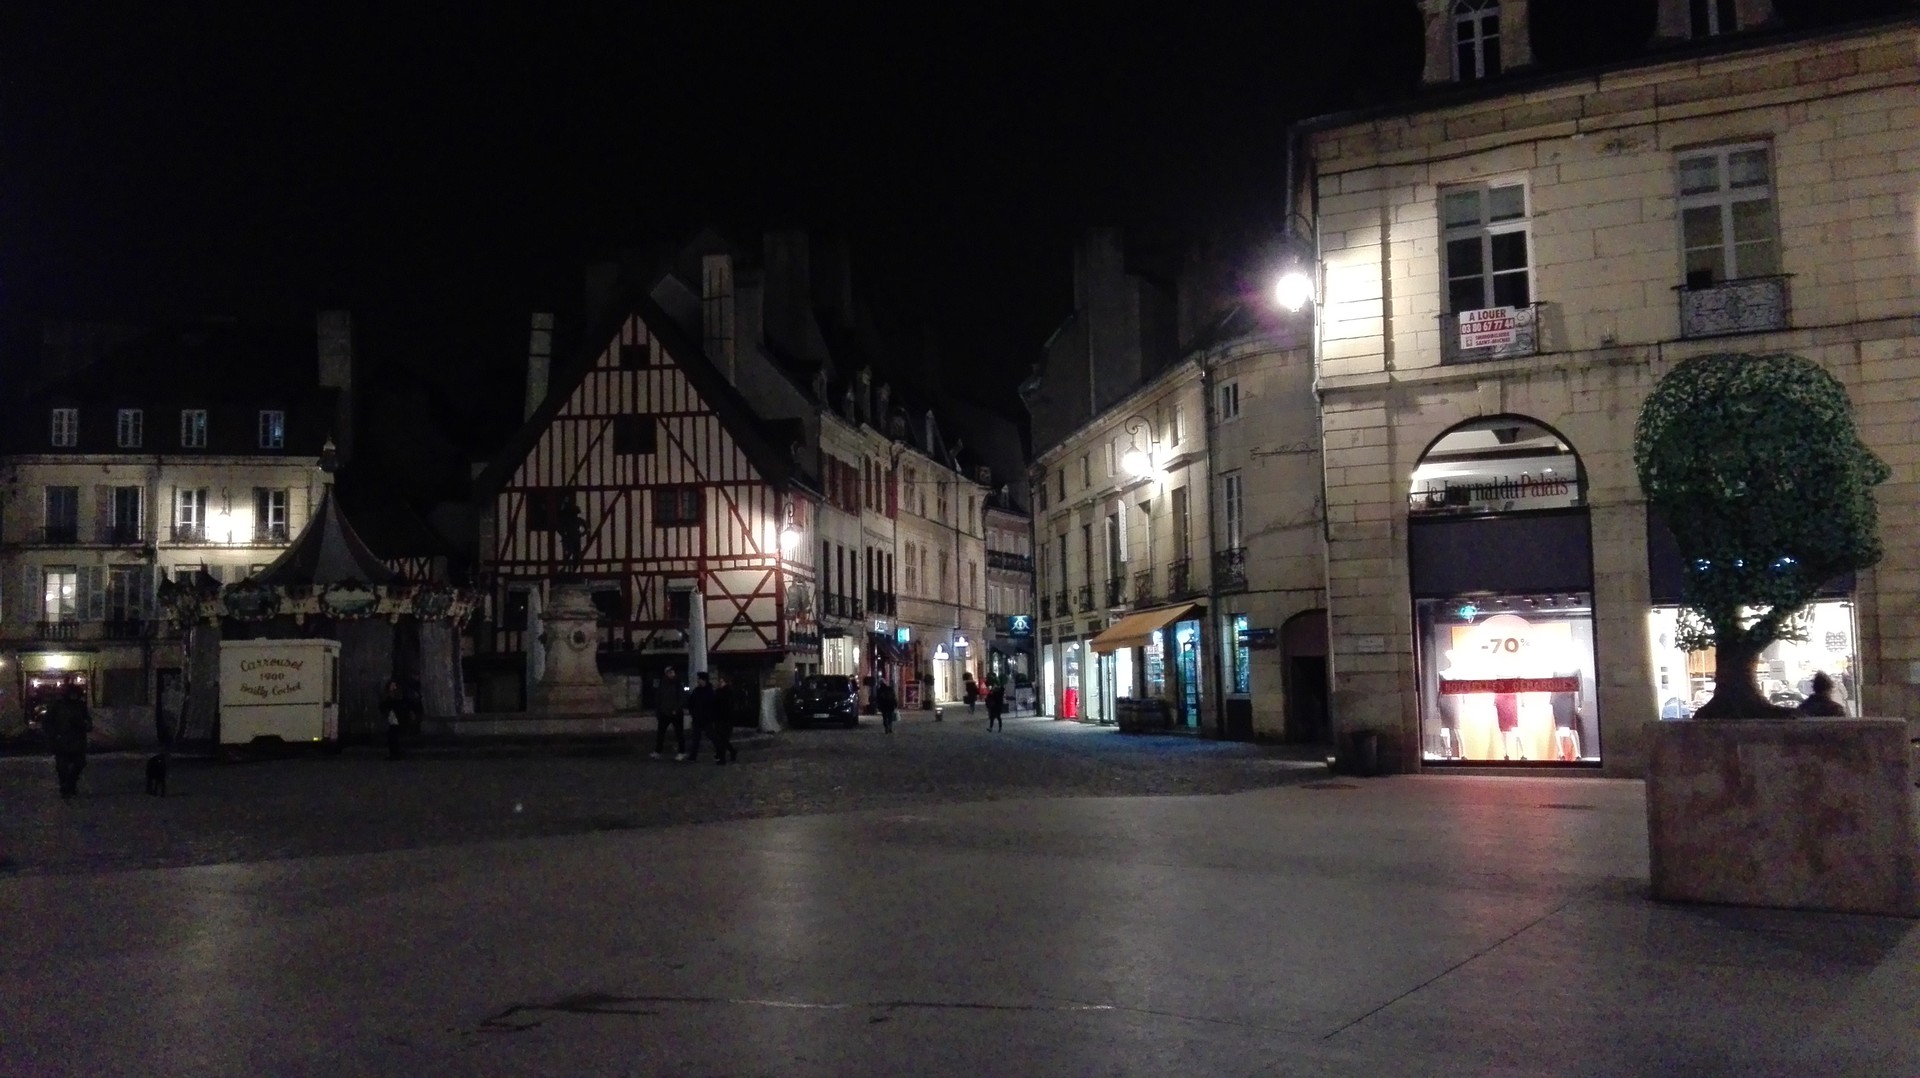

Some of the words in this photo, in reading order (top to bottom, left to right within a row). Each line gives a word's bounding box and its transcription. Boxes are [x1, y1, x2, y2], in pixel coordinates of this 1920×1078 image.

[1477, 309, 1507, 320] LOUER
[1461, 323, 1471, 334] 03
[1483, 321, 1492, 332] 67
[1493, 319, 1503, 330] 77
[1504, 318, 1514, 329] 44
[1499, 475, 1519, 499] du
[1520, 472, 1569, 498] Palais
[240, 658, 303, 672] Carrousel
[260, 672, 285, 681] 1900
